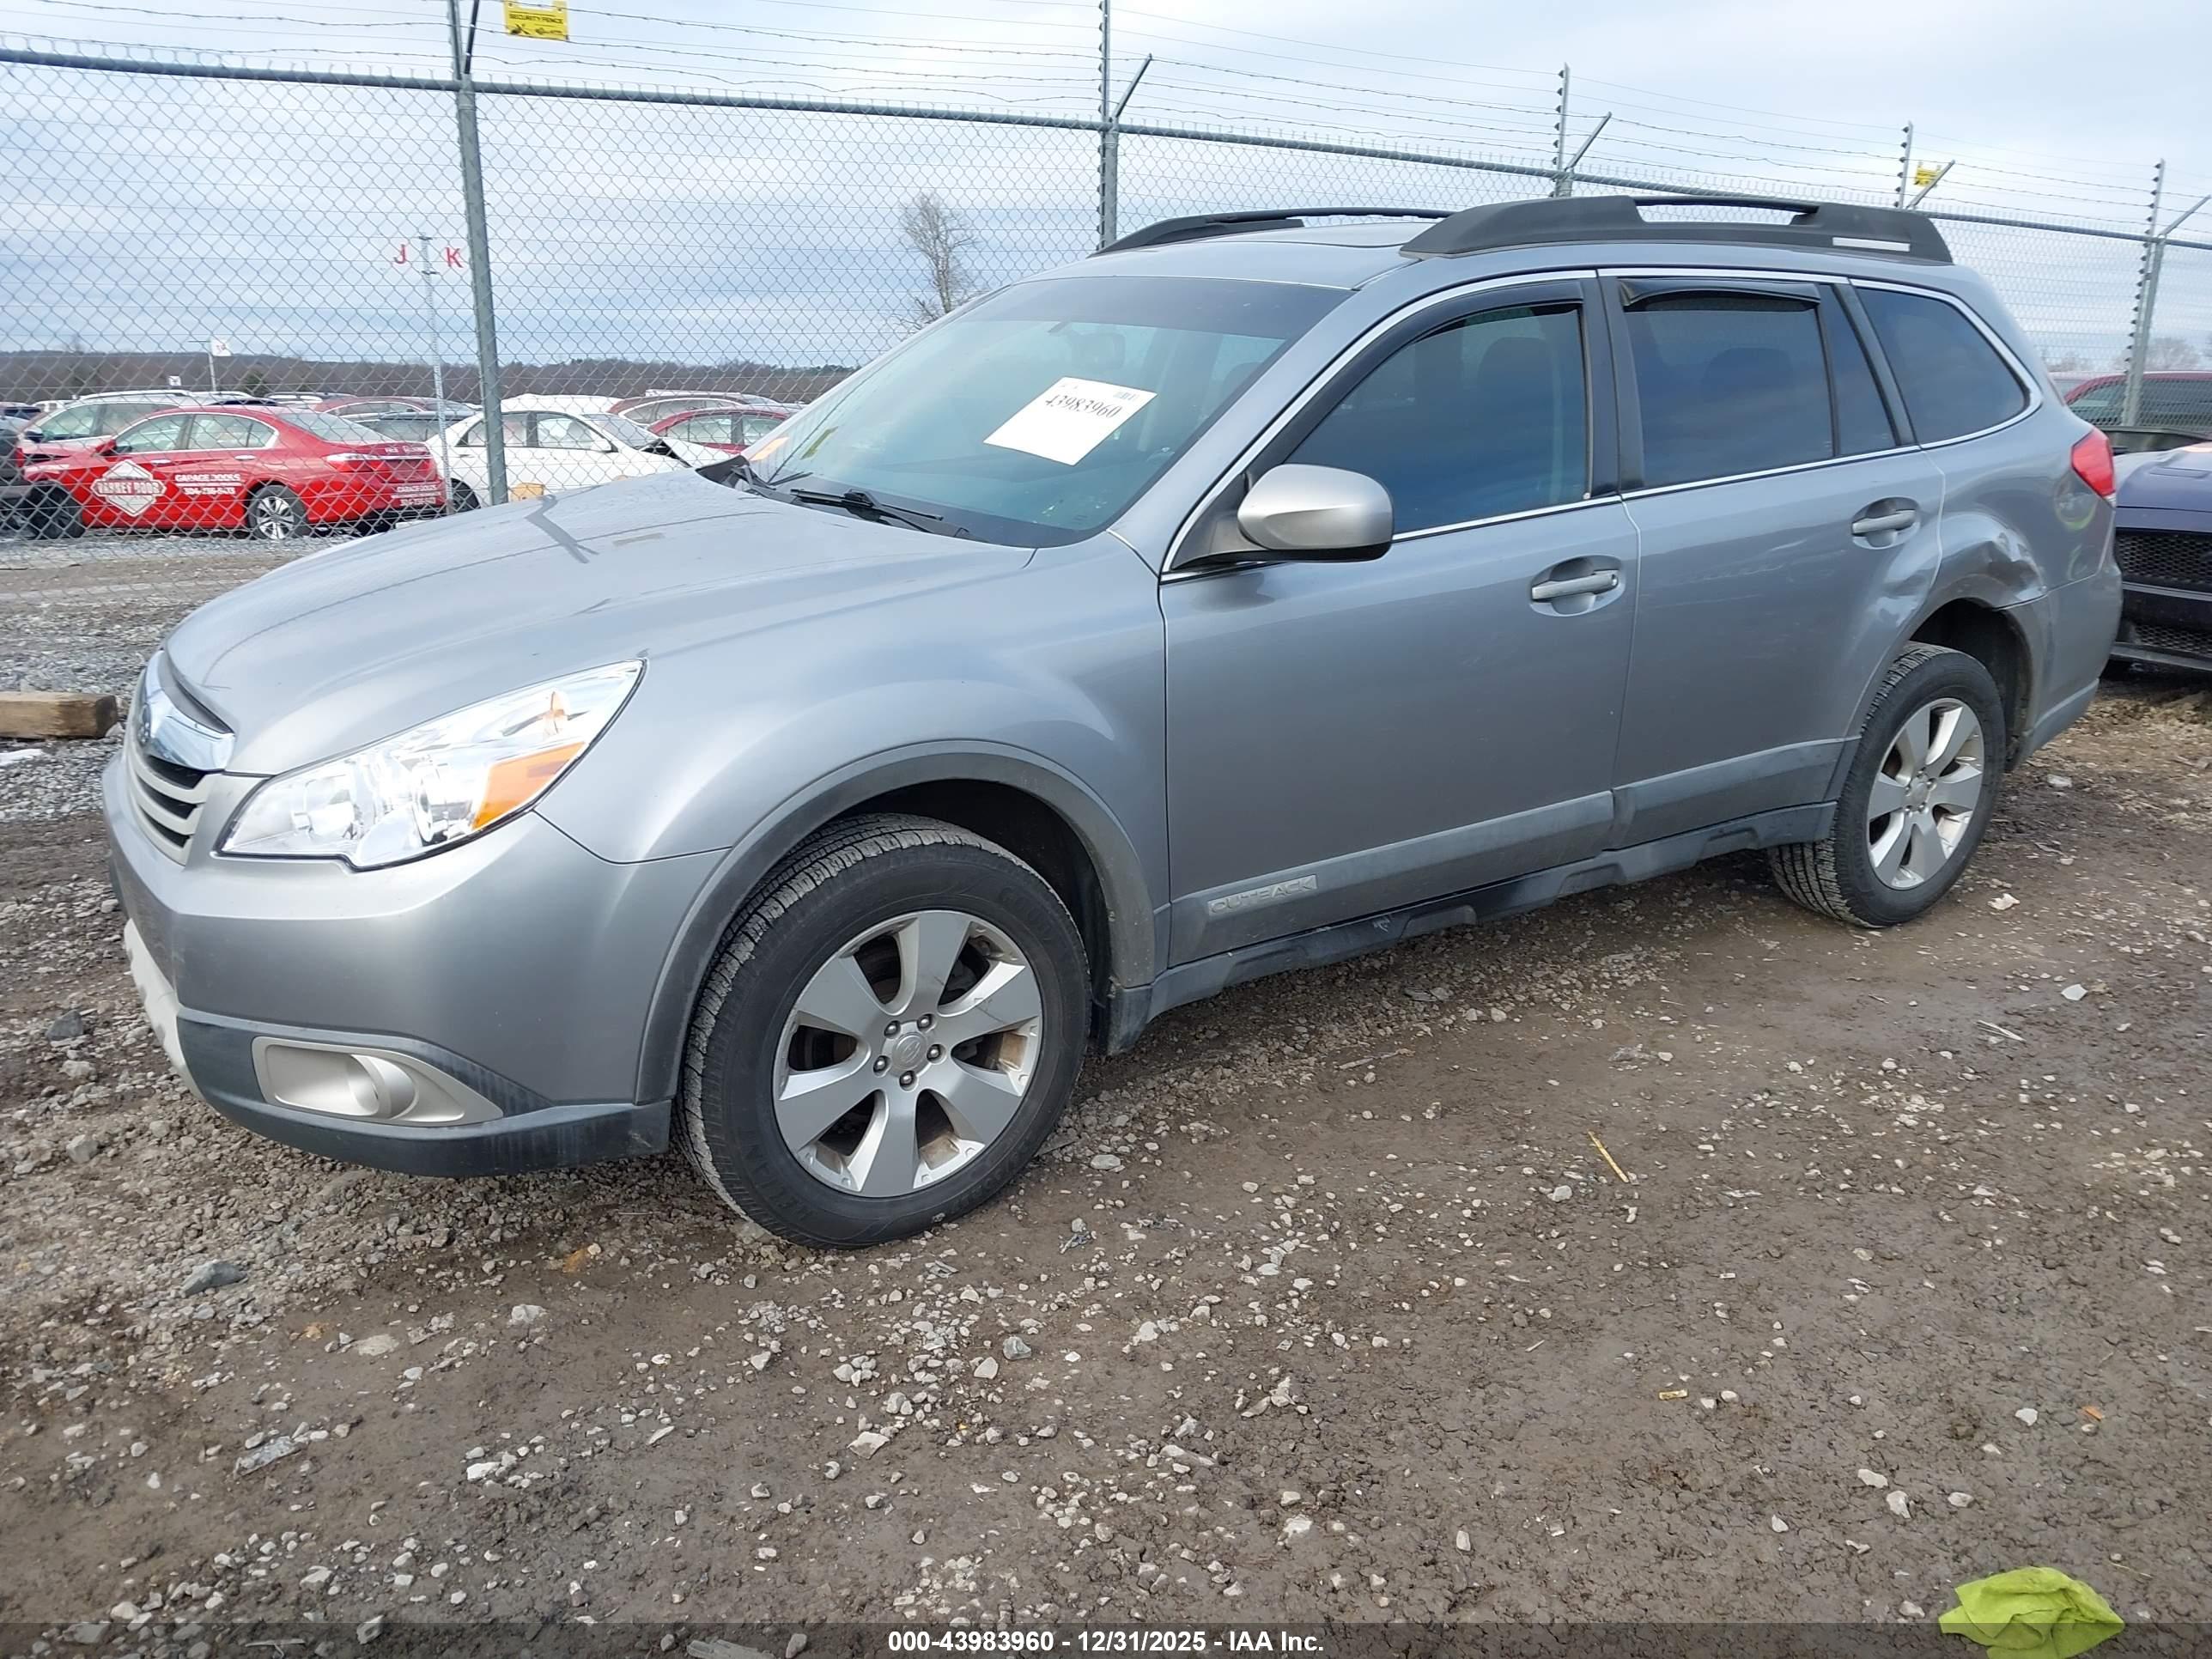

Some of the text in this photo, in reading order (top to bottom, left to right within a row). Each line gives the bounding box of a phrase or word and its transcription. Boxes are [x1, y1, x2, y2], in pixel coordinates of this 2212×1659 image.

[393, 244, 406, 264] J
[445, 247, 463, 268] K
[1045, 393, 1123, 418] 43983960
[1210, 876, 1316, 914] OUTBACK
